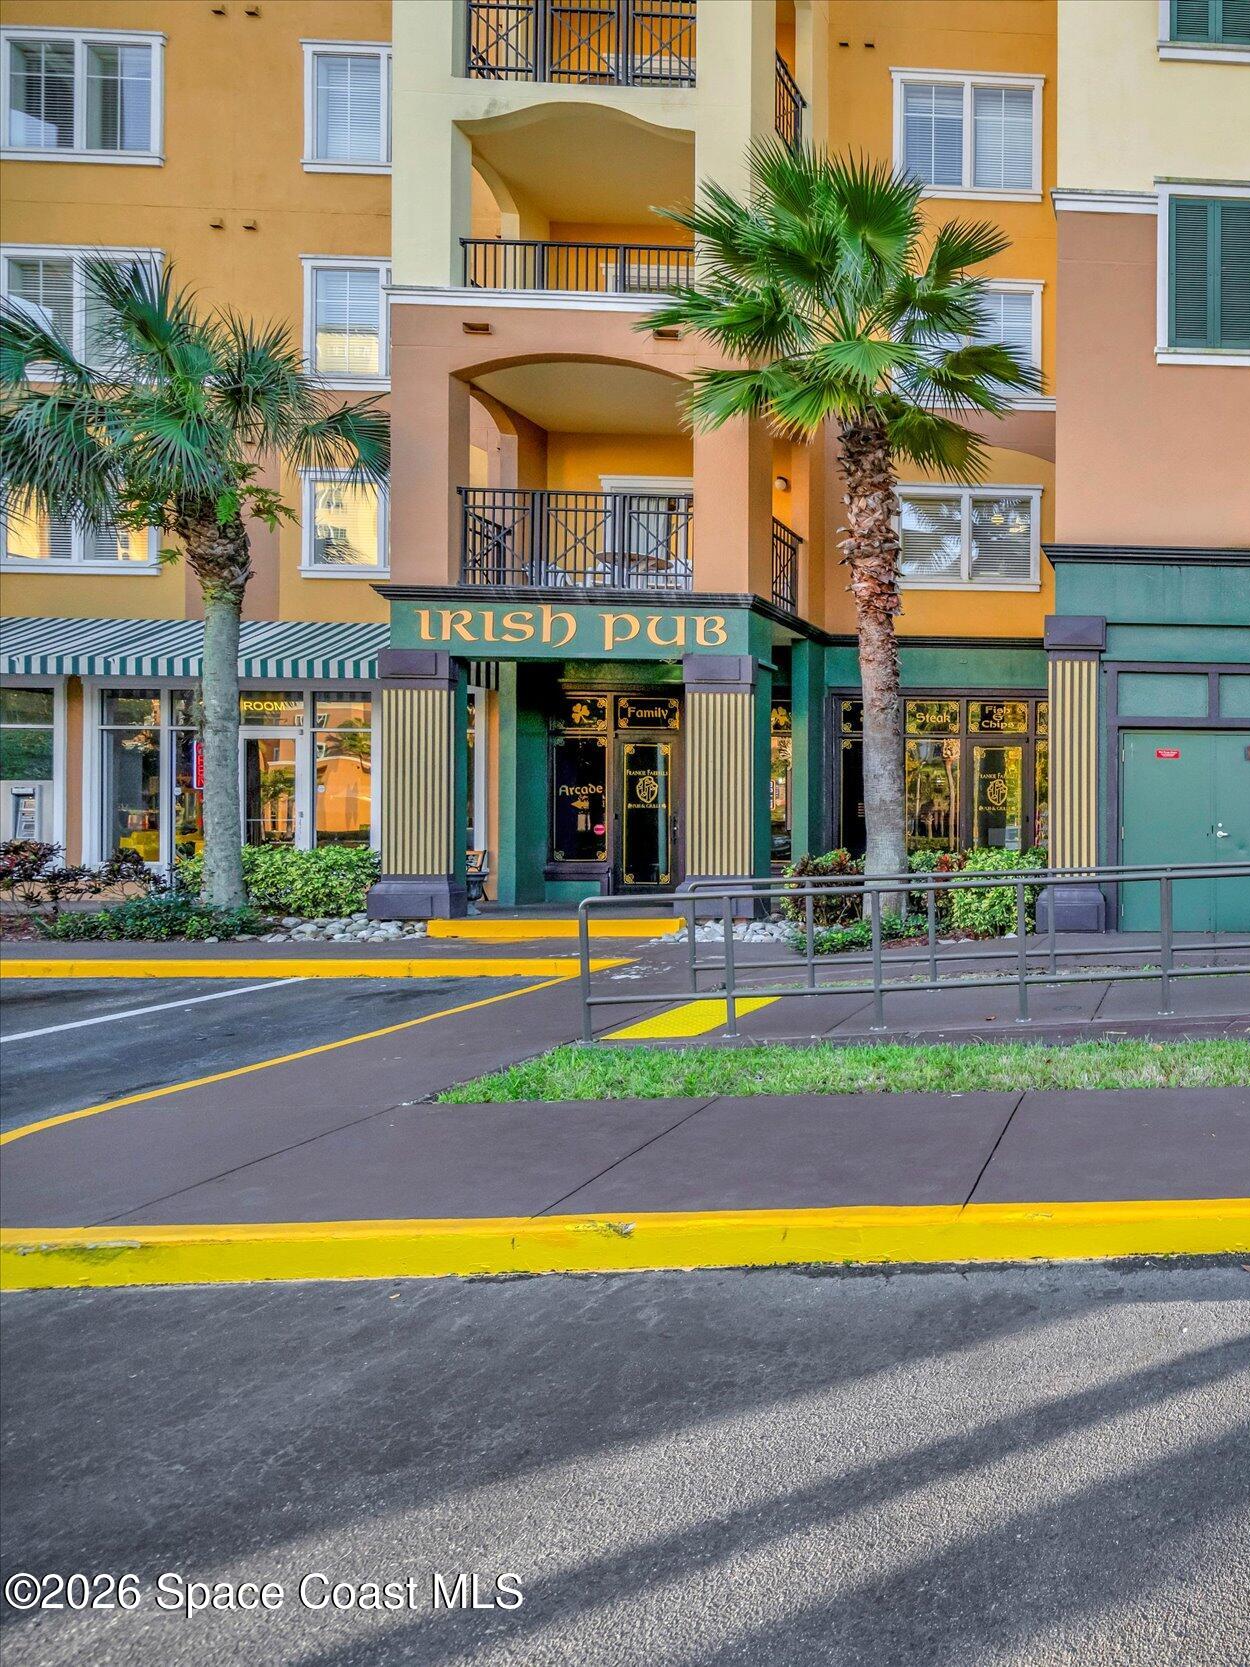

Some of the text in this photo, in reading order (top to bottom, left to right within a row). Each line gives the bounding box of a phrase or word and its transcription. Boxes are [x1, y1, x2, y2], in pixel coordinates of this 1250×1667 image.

[415, 603, 729, 651] IRISH PUB
[627, 706, 669, 719] Family
[985, 705, 1011, 714] Fish
[916, 712, 951, 723] Steak
[981, 720, 1015, 729] Chips
[559, 784, 604, 796] Arcade
